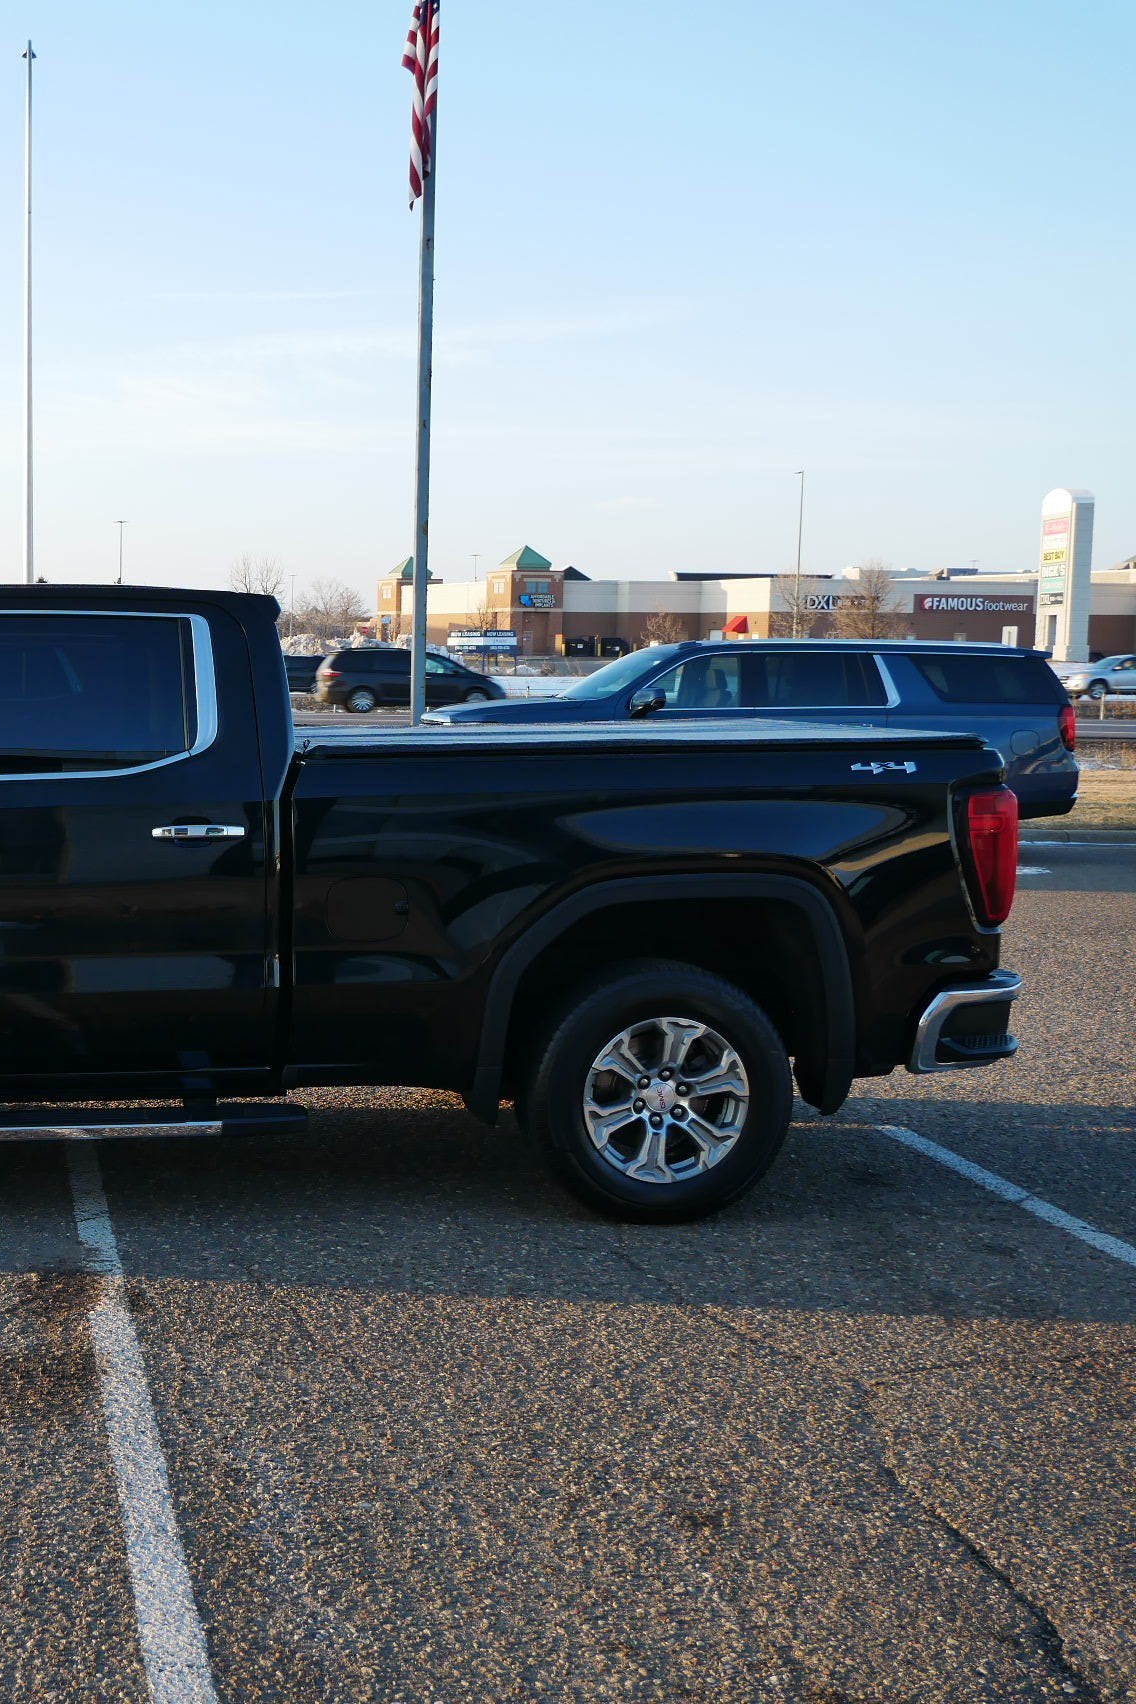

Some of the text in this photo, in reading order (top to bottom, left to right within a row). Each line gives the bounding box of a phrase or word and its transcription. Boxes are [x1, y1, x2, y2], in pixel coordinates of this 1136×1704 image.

[806, 595, 838, 609] DXL
[932, 597, 1028, 611] FAMOUS footwear
[657, 1086, 666, 1109] GMC
